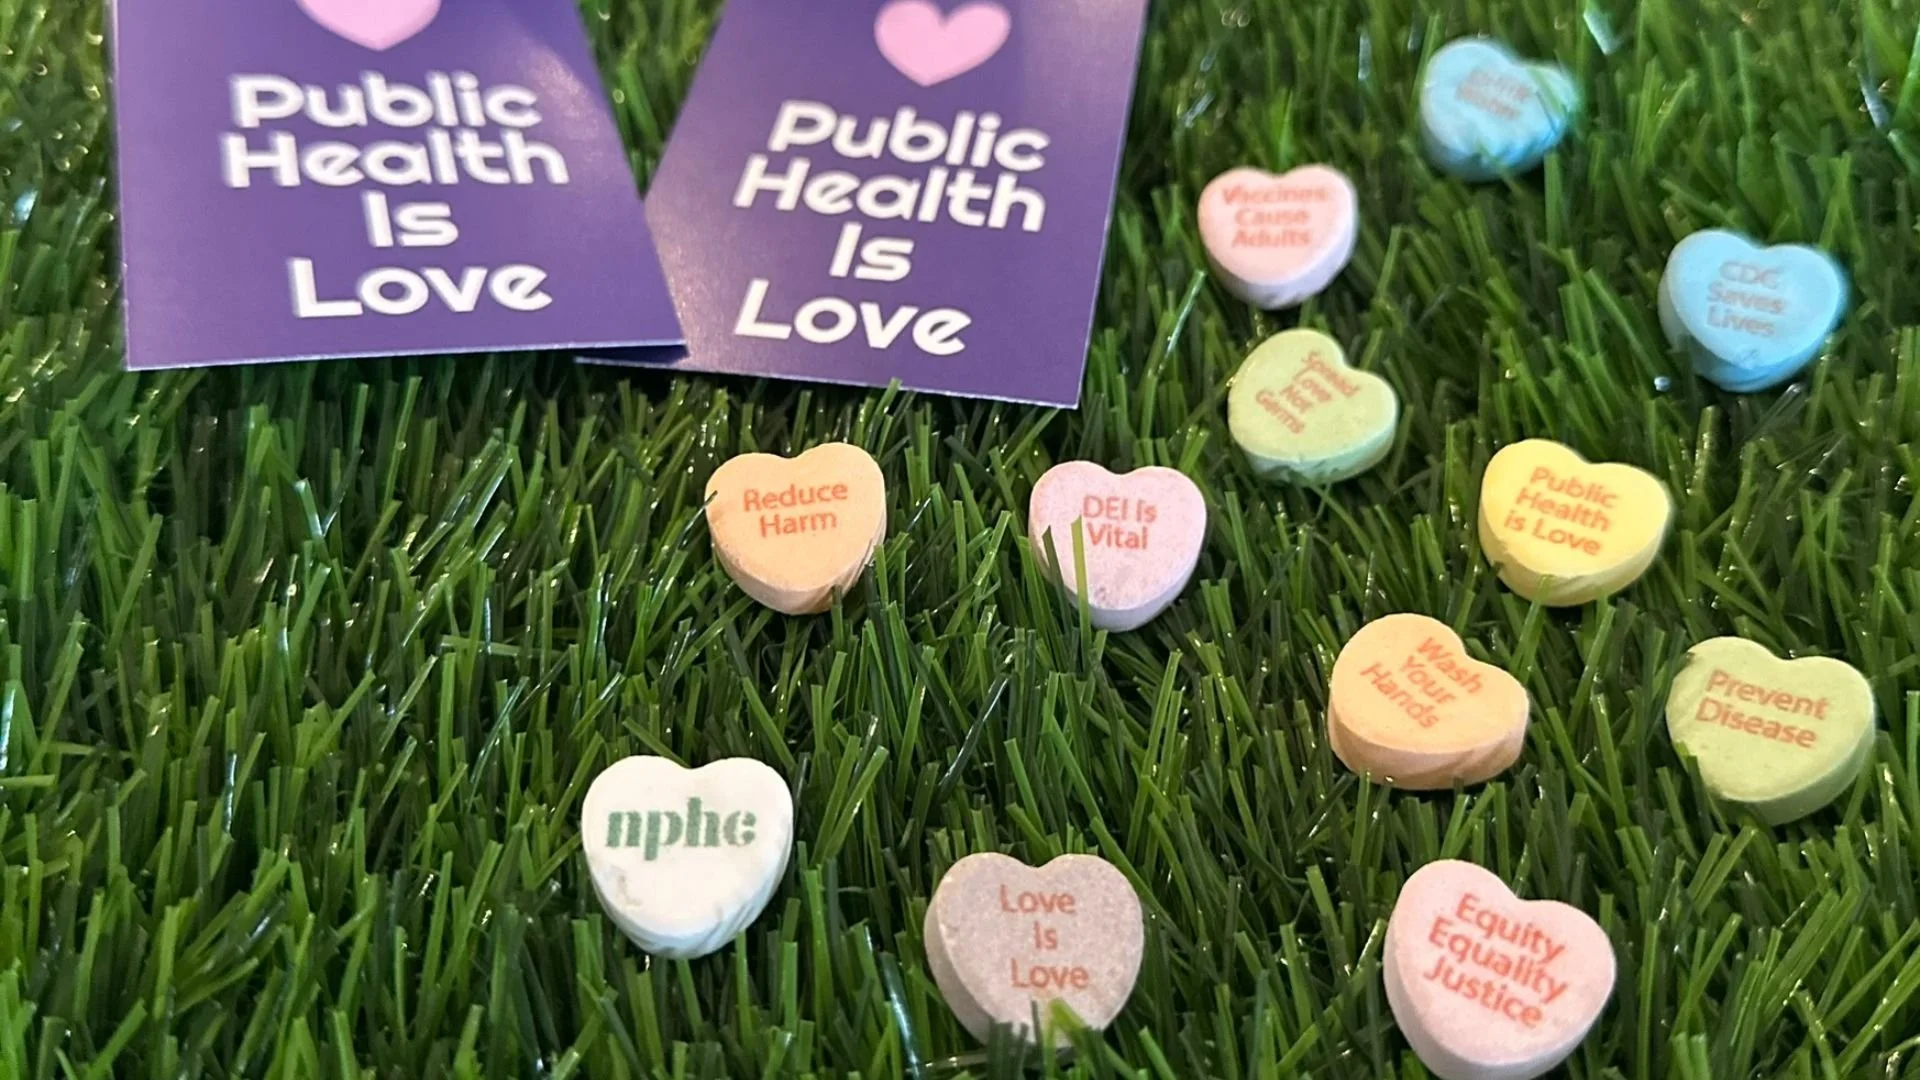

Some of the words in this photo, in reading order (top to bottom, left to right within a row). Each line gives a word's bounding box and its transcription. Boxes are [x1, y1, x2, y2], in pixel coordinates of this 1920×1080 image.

[230, 70, 542, 127] Public
[220, 127, 569, 187] Health
[768, 100, 1049, 171] Public
[733, 154, 1045, 232] Health
[1222, 184, 1328, 205] Vaccines
[1235, 208, 1311, 226] Cause
[361, 190, 459, 247] Is
[829, 222, 914, 281] Is
[1719, 260, 1782, 289] CDC
[288, 256, 552, 318] Love
[1706, 280, 1785, 315] Saves
[734, 278, 971, 355] Love
[1706, 304, 1775, 337] Lives
[743, 482, 848, 512] Reduce
[1083, 495, 1128, 521] DEI
[1515, 487, 1611, 532] Health
[1530, 466, 1618, 508] Public
[760, 511, 837, 538] Harm
[1086, 521, 1149, 550] Vital
[1504, 509, 1526, 532] is
[1532, 518, 1602, 556] Love
[1400, 655, 1456, 703] Your
[1417, 637, 1483, 694] Wash
[1359, 661, 1440, 728] Hands
[1705, 668, 1830, 721] Prevent
[1695, 696, 1817, 748] Disease
[605, 796, 757, 861] nphc
[1000, 884, 1076, 915] Love
[1033, 920, 1058, 951] Is
[1456, 892, 1565, 964] Equity
[1010, 957, 1089, 989] Love
[1428, 916, 1568, 1004] Equality
[1423, 955, 1543, 1029] Justice
